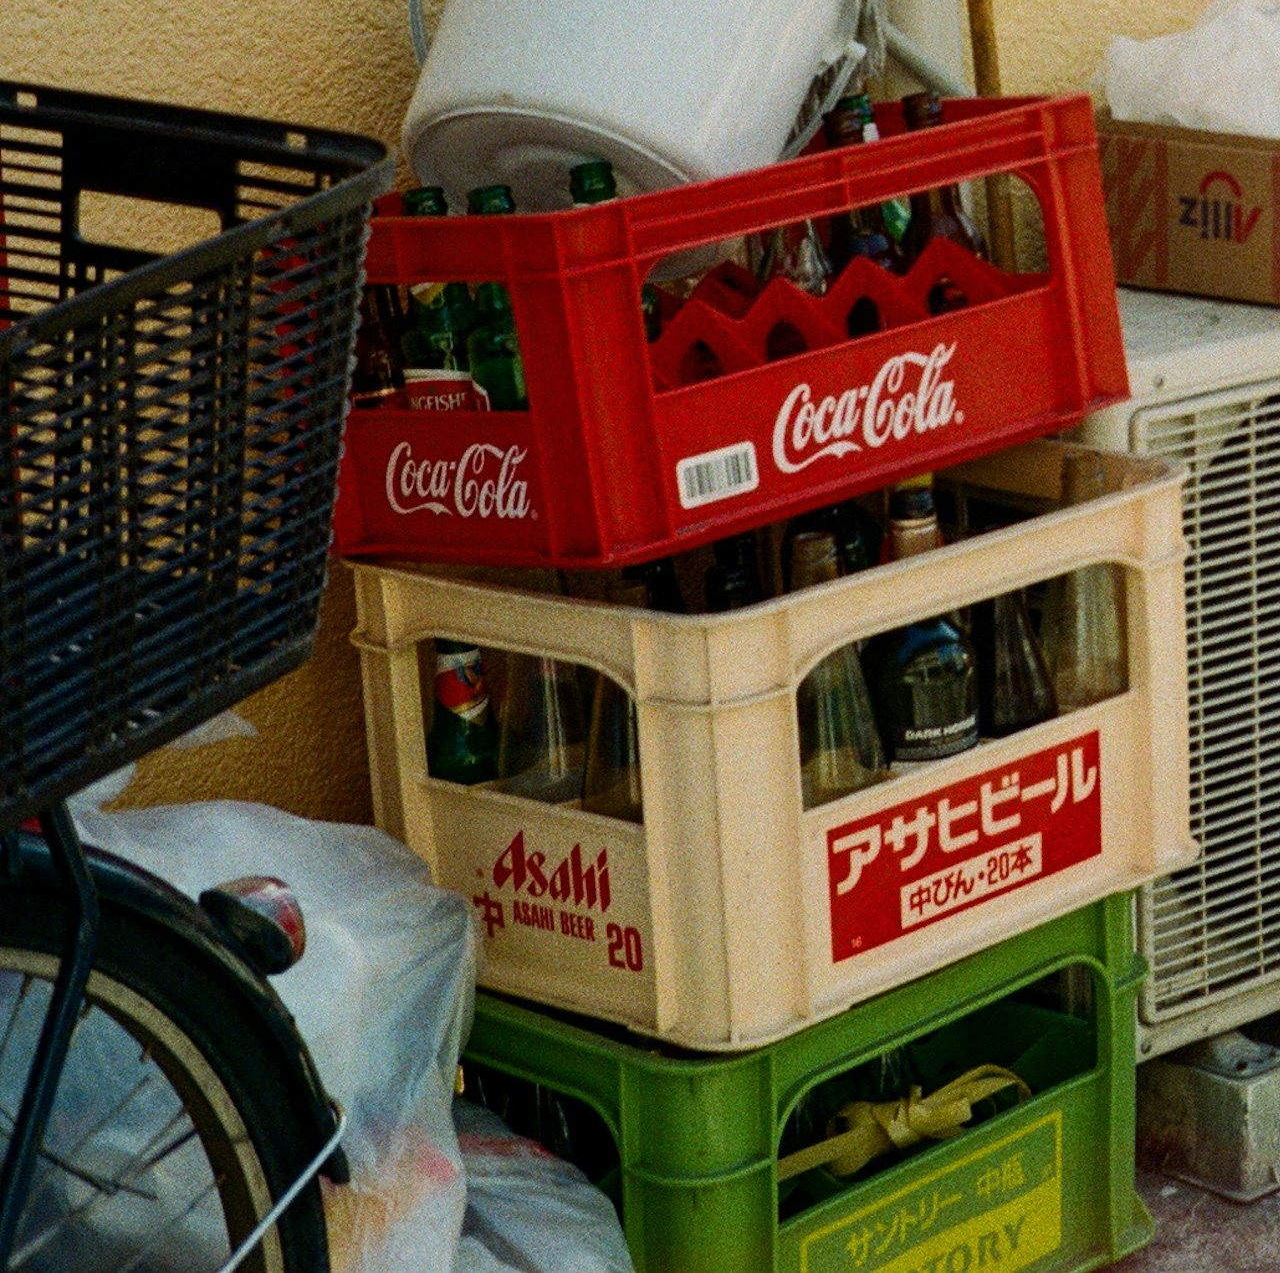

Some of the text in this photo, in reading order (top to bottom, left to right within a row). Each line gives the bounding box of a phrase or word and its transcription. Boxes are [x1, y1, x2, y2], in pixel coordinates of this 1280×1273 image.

[772, 341, 958, 473] Coca-Cola
[386, 441, 531, 519] Coca-Cola
[905, 727, 942, 741] DARK
[833, 747, 1098, 896] アサヒビール
[493, 829, 611, 913] Asahi
[909, 844, 1033, 915] 中びん・20本
[473, 891, 643, 972] 中 ASAHI BEER 20
[845, 1189, 963, 1266] サントリー
